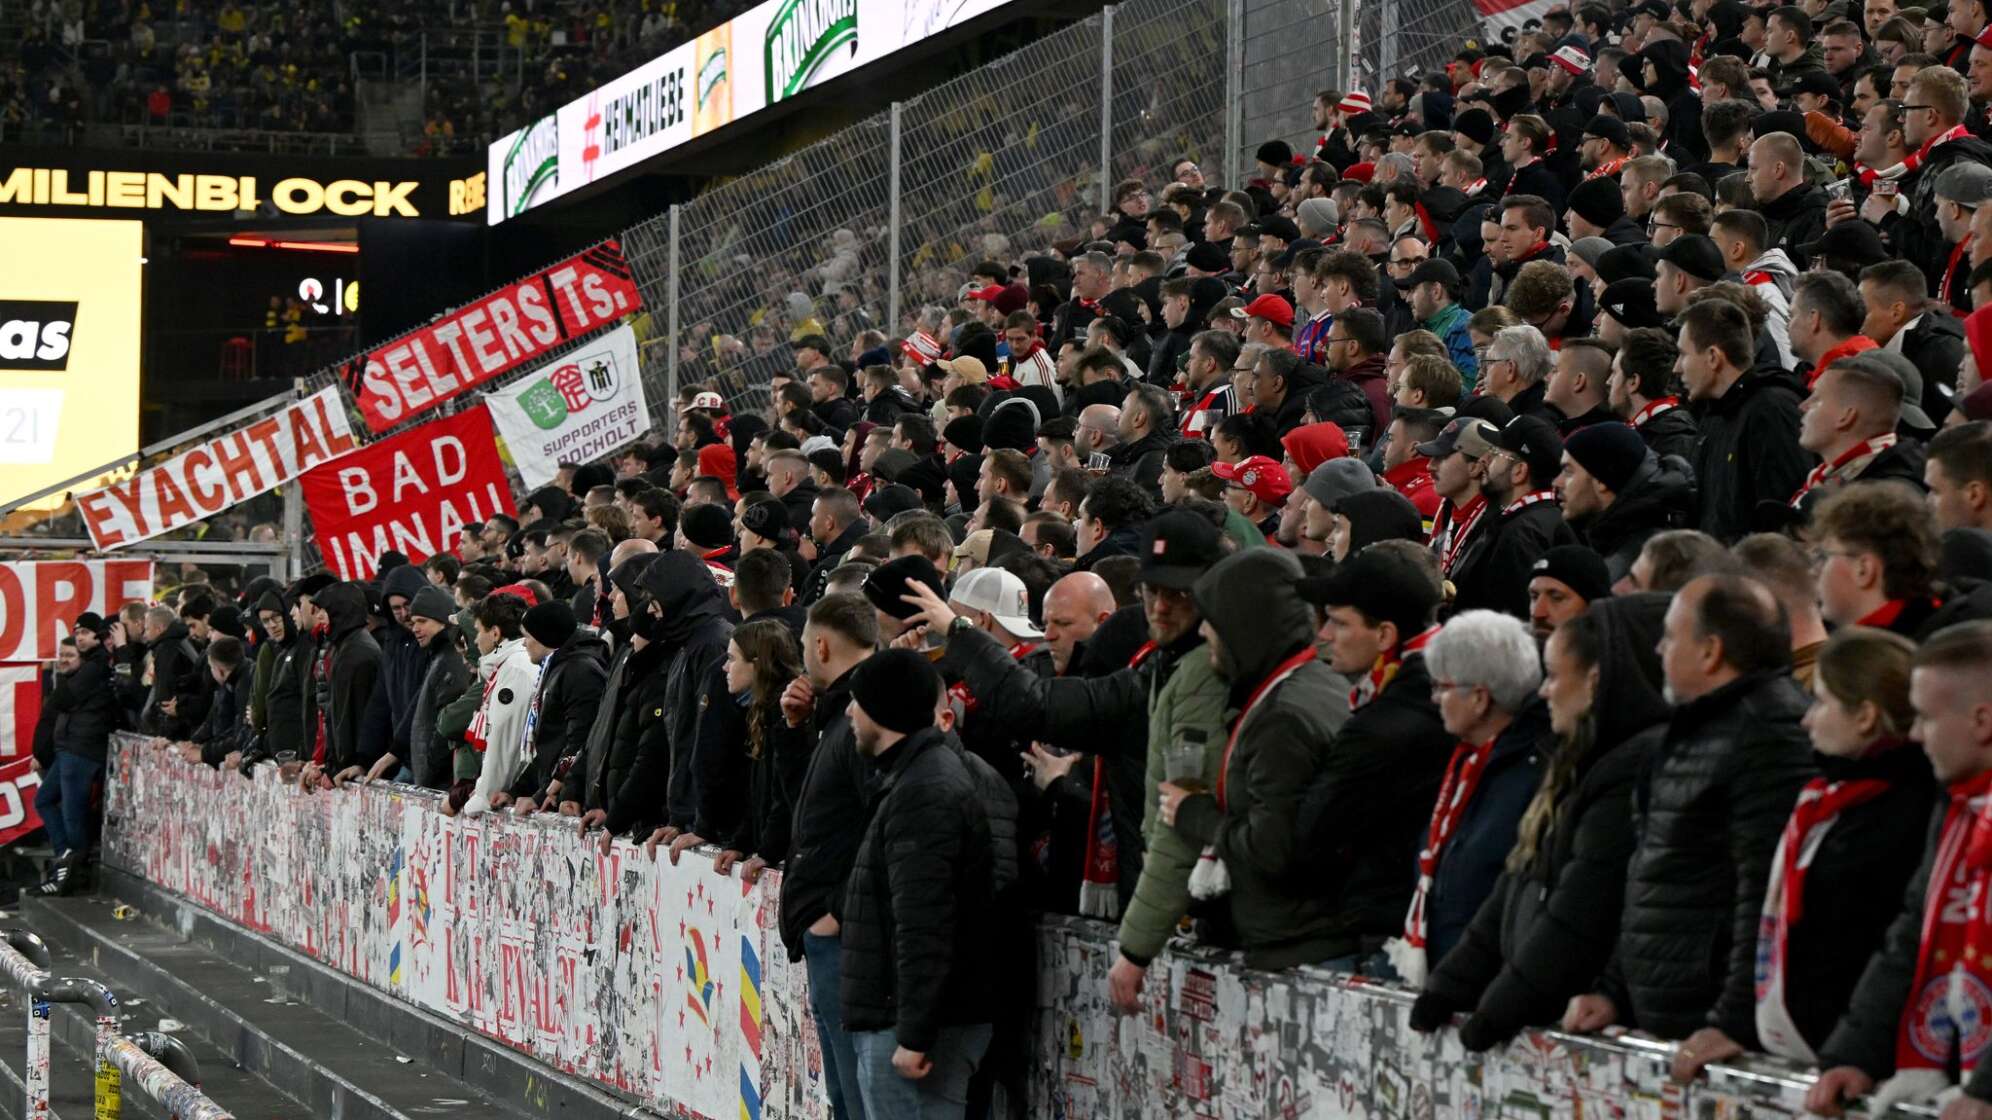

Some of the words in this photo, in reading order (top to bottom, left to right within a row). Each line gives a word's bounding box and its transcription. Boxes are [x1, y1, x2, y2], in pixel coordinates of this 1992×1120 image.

[543, 400, 638, 457] SUPPORTERS
[78, 395, 355, 549] EYACHTAL
[339, 434, 467, 517] BAD
